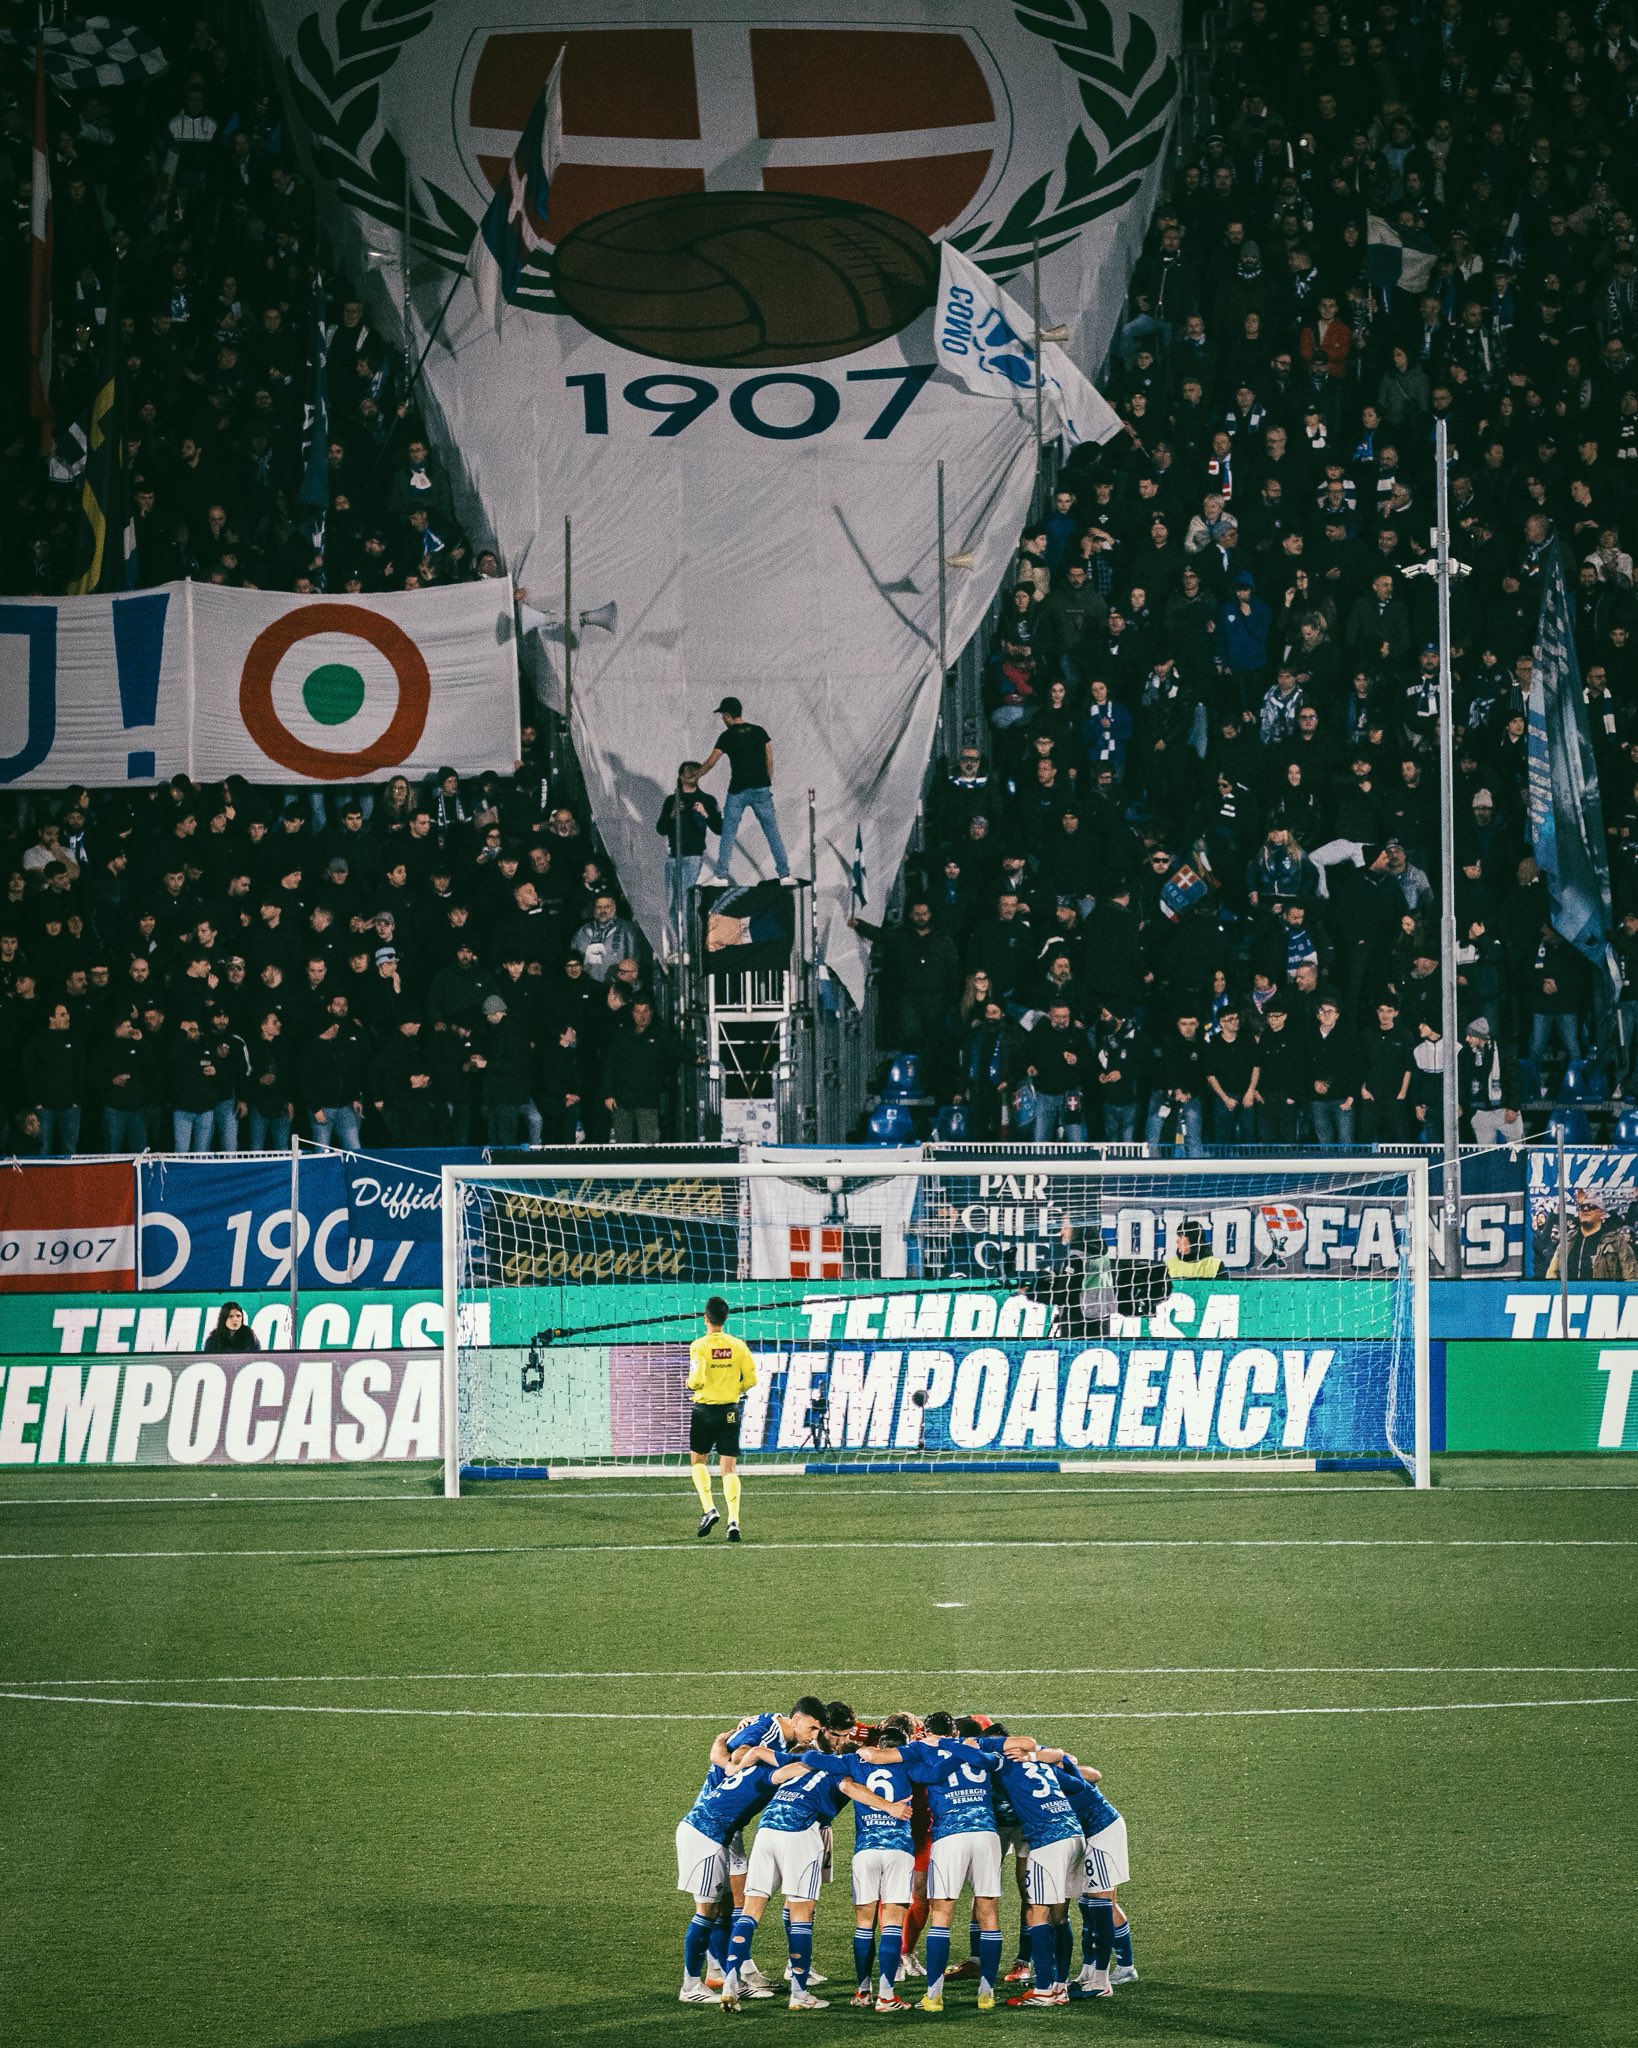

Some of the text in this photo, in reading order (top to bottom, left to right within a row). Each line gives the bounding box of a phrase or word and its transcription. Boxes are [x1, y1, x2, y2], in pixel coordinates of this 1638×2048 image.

[942, 286, 973, 355] COMO
[565, 363, 938, 440] 1907
[979, 1174, 1049, 1200] PAR
[33, 1239, 117, 1265] 1907
[0, 1358, 441, 1464] EMPOCASA
[739, 1348, 1336, 1450] TEMPOAGENCY
[866, 1768, 895, 1812] 6
[944, 1788, 987, 1800] NEUBERGER
[953, 1796, 984, 1805] BERMAN
